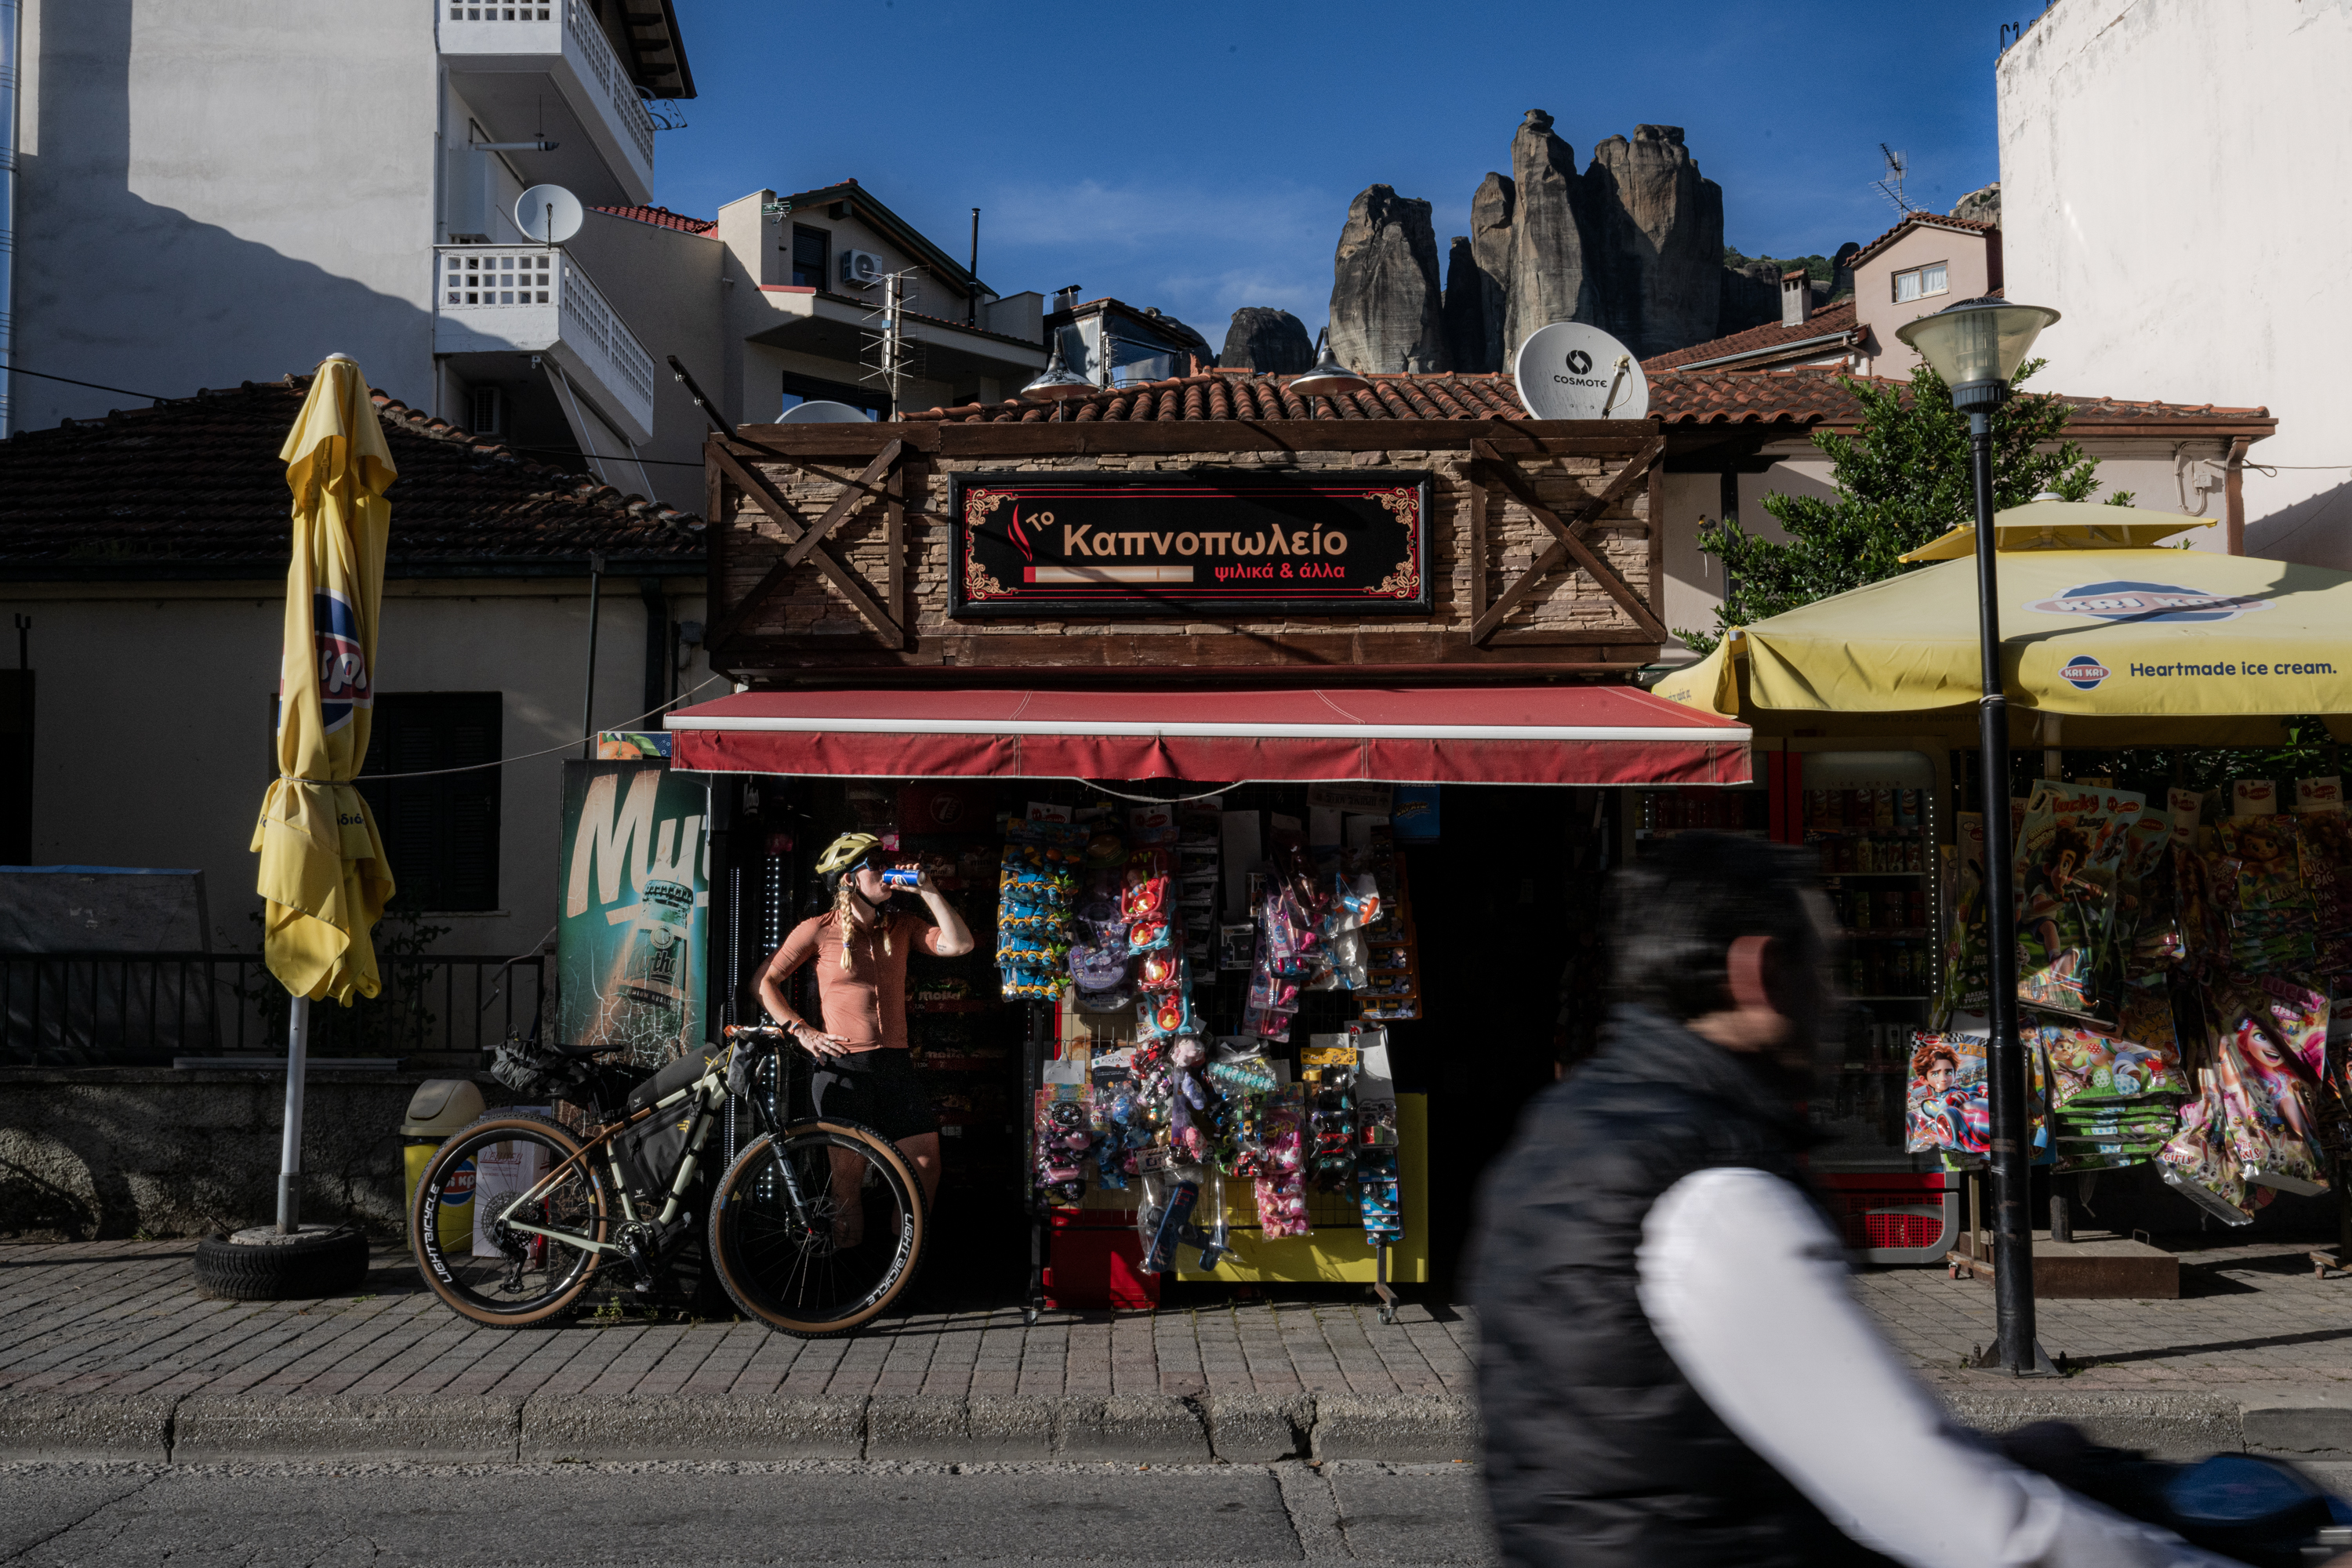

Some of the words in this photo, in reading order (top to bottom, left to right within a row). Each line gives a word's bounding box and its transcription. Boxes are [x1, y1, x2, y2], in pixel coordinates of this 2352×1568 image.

[1554, 375, 1607, 387] COSMOTE
[1025, 511, 1054, 532] Το
[1063, 523, 1348, 557] Καπνοπωλείο
[1215, 562, 1273, 583] ψιλικά
[1279, 564, 1294, 579] &
[1299, 562, 1345, 579] άλλα
[2054, 597, 2145, 611] KRI
[2064, 669, 2082, 677] KRI
[2085, 669, 2103, 677] KRI
[2130, 662, 2236, 677] Heartmade
[2241, 661, 2268, 676] ice
[2274, 662, 2337, 675] cream.
[2077, 815, 2107, 829] bag
[2303, 862, 2334, 878] LUCKY
[2314, 871, 2336, 886] BAG
[2261, 975, 2326, 1013] LUCKY
[2270, 998, 2303, 1022] BAG
[1958, 1043, 1987, 1058] LUC
